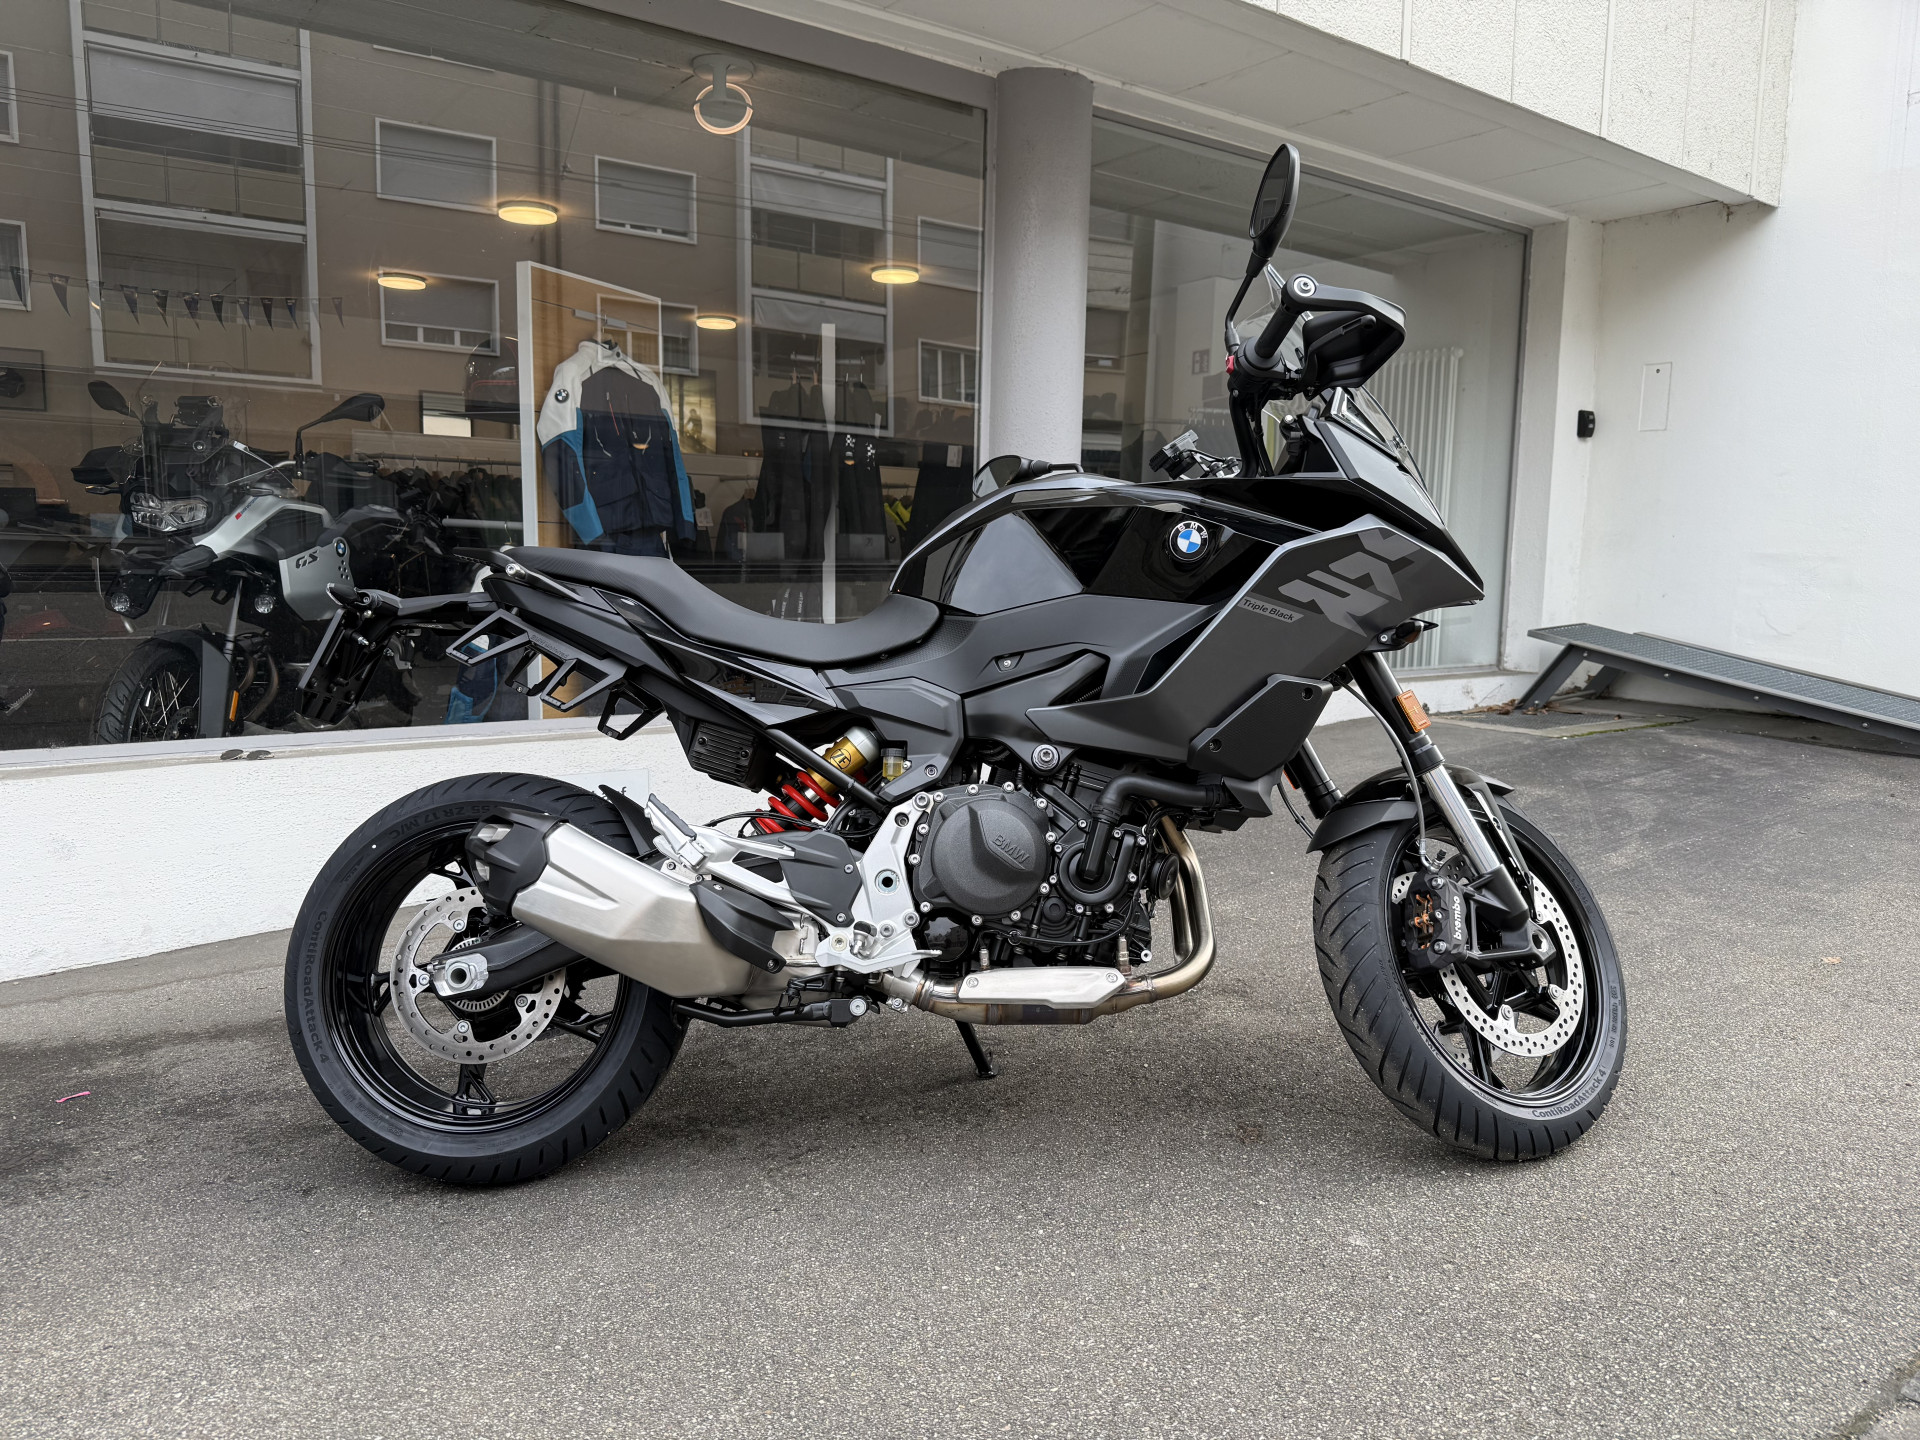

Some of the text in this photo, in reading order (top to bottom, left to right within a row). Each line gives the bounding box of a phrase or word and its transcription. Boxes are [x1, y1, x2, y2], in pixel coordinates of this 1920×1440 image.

[296, 550, 318, 569] GS
[1243, 598, 1294, 621] Triple Black
[830, 748, 851, 770] ZF
[424, 812, 439, 826] 17
[443, 807, 464, 818] ZR
[388, 818, 420, 839] M/C
[992, 834, 1030, 864] BMW
[1452, 895, 1462, 940] brembo
[302, 910, 330, 1064] ContiRoadAttack 4
[1531, 1068, 1607, 1118] ContiRoadAttack 4
